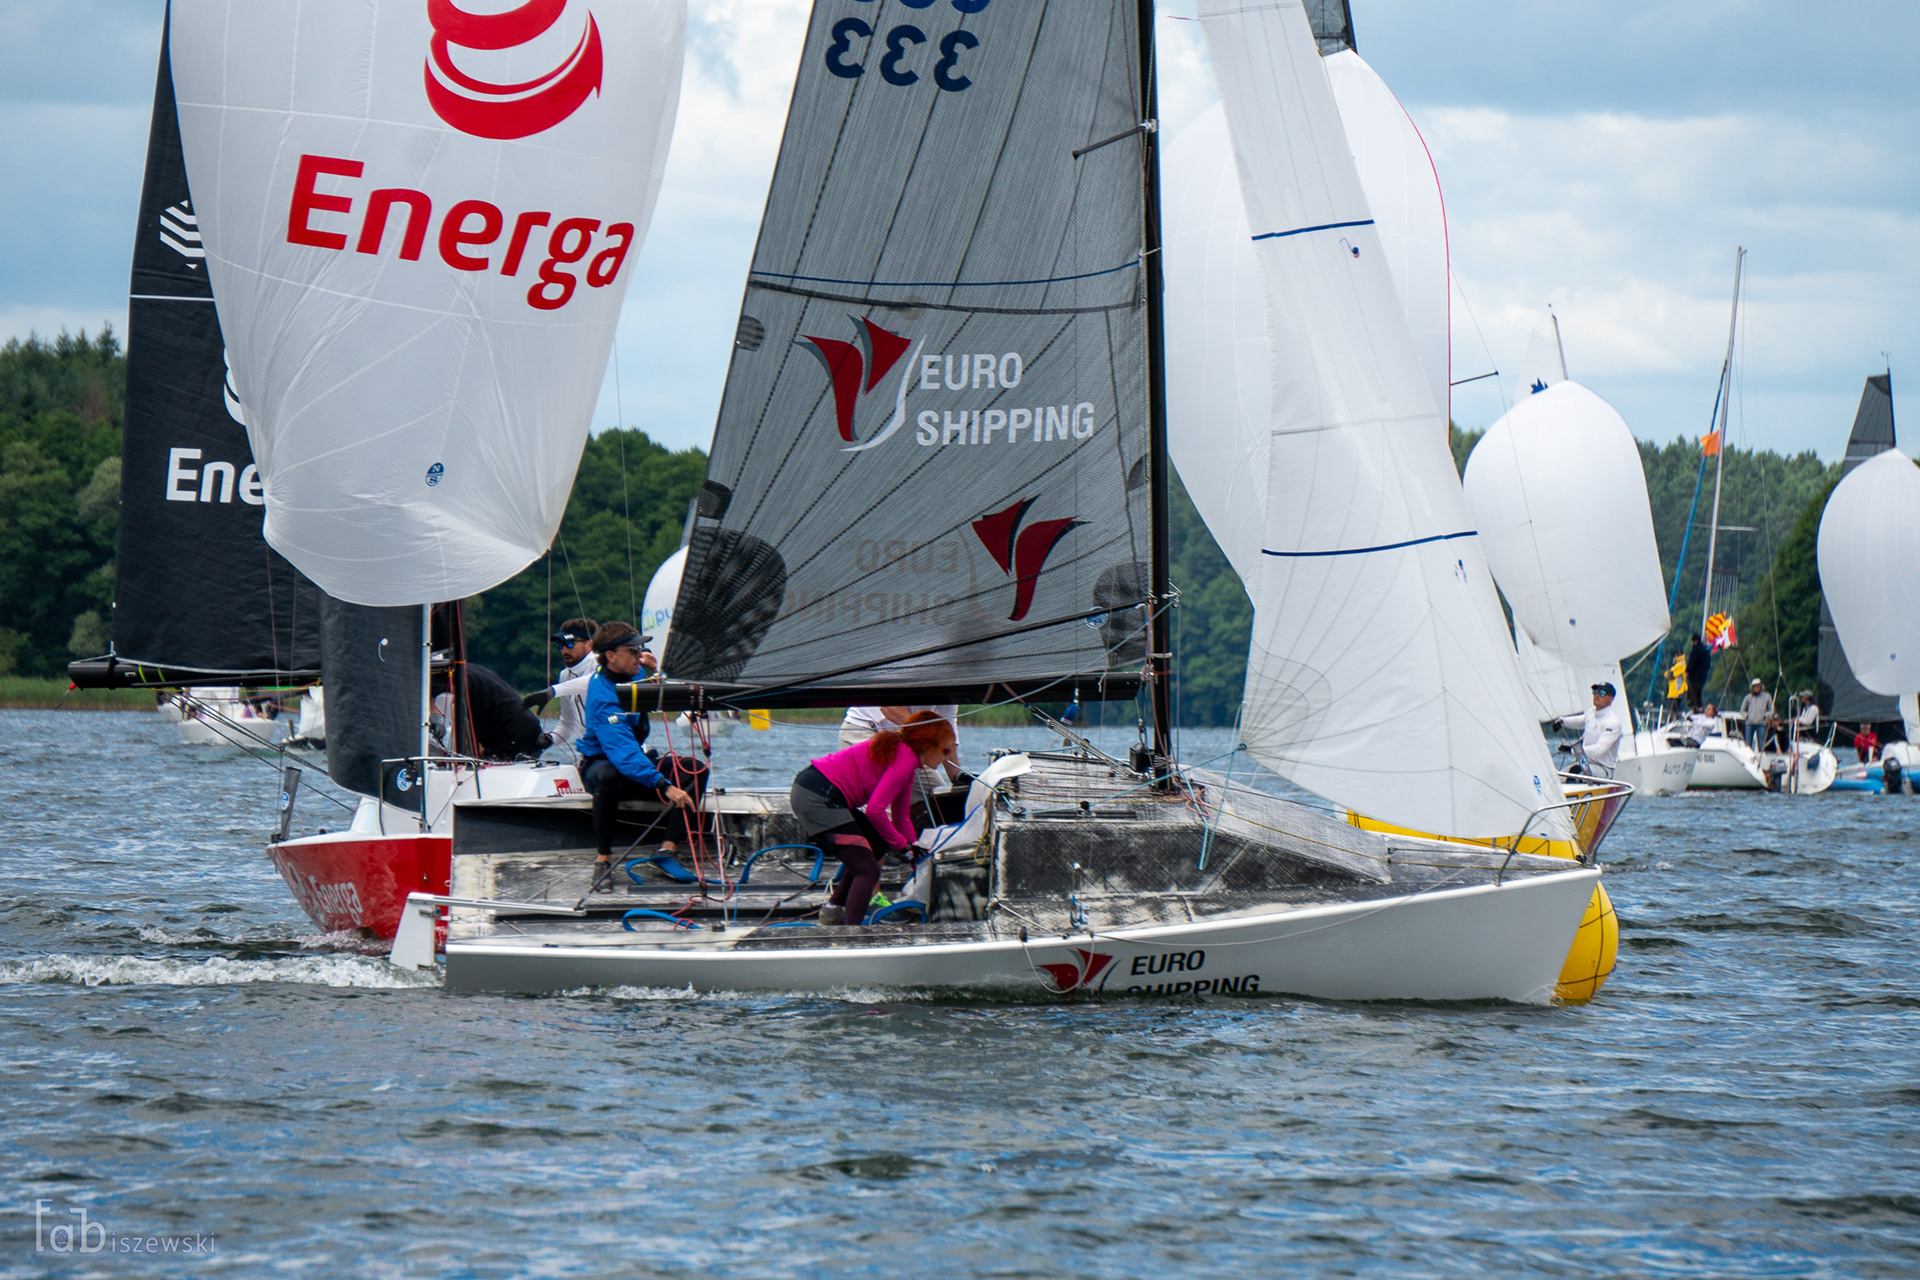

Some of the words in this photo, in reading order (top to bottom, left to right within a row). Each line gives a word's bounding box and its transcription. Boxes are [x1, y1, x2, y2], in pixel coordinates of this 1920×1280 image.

[287, 154, 635, 310] Energa
[920, 352, 1023, 390] EURO
[916, 402, 1095, 446] SHIPPING
[307, 875, 363, 925] Energa
[1130, 950, 1206, 976] EURO
